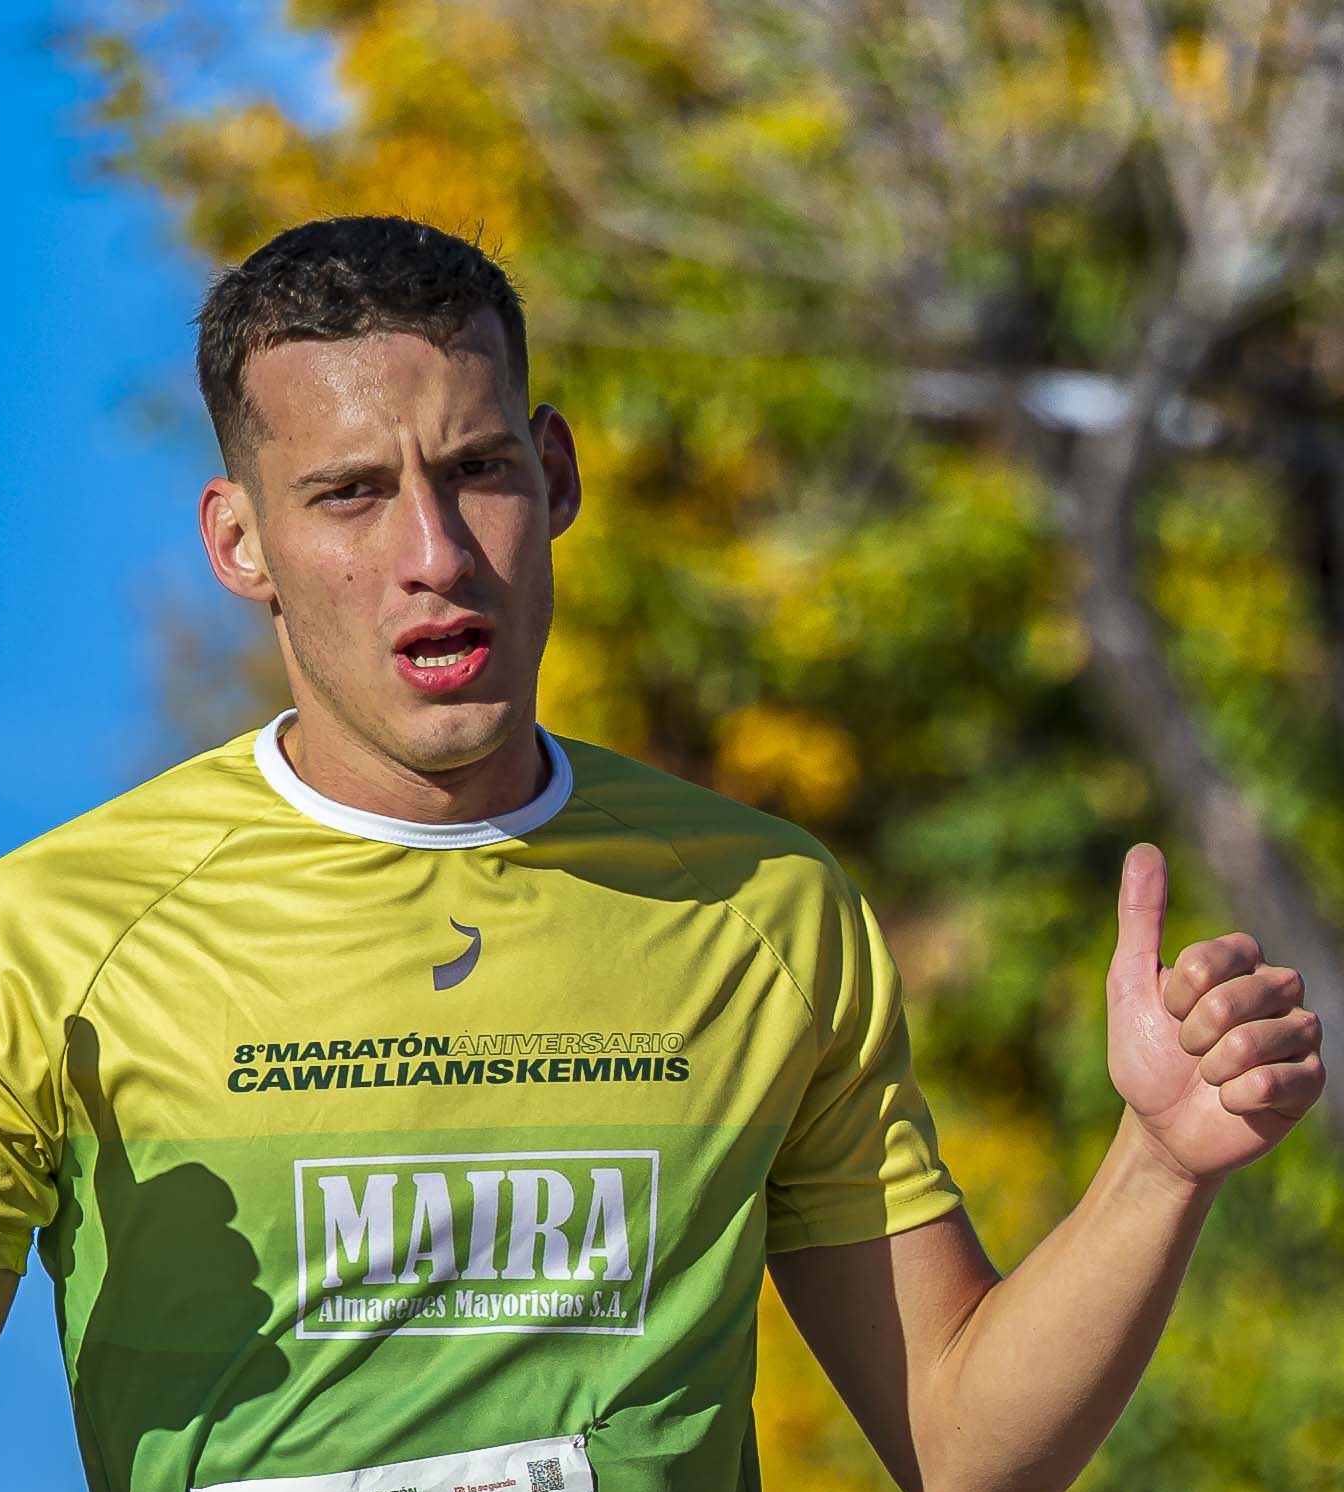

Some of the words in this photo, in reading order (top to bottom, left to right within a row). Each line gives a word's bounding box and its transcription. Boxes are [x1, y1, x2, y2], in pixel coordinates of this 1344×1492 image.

[445, 1033, 685, 1056] ANIVERSARIO
[227, 1057, 690, 1093] CAWILLIAMSKEMMIS
[318, 1168, 633, 1289] MAIRA
[318, 1292, 447, 1323] Almacenes
[454, 1289, 583, 1320] Mayoristas
[590, 1291, 627, 1319] S.A.
